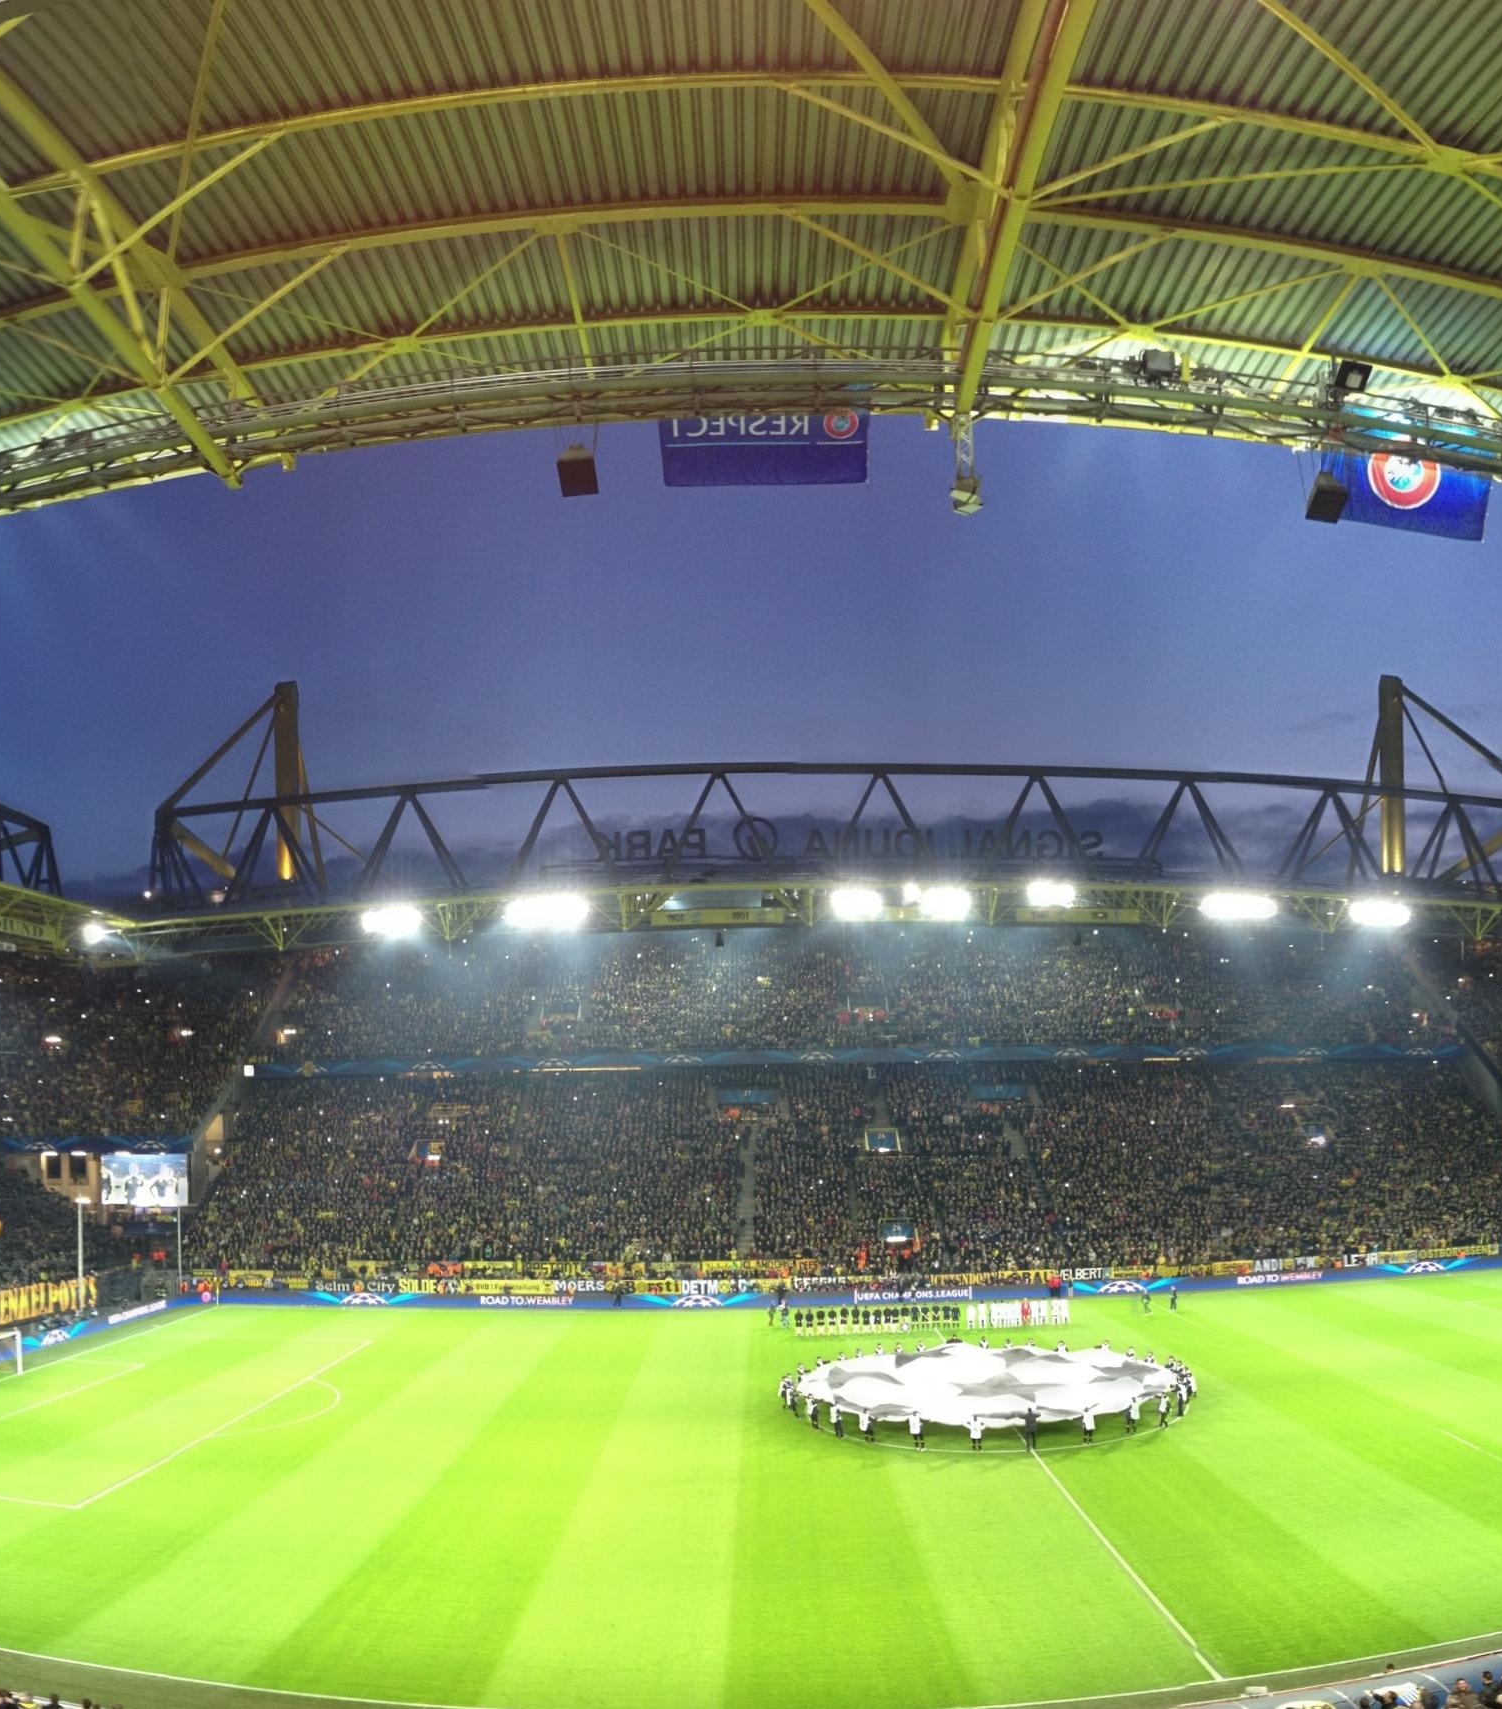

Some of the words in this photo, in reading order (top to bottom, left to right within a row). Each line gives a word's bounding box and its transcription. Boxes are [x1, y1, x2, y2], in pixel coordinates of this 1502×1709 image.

[1236, 1274, 1265, 1285] ROAD
[1266, 1273, 1280, 1283] TO
[1280, 1271, 1323, 1282] WEMBLEY
[315, 1280, 350, 1293] Selm
[367, 1280, 397, 1294] City
[554, 1280, 606, 1293] MOERS
[480, 1295, 510, 1306] ROAD
[511, 1295, 525, 1306] TO
[526, 1295, 575, 1306] WEMBLEY
[857, 1292, 881, 1301] UEFA
[882, 1290, 933, 1301] CHAMPONS
[935, 1289, 969, 1299] LEAGUE
